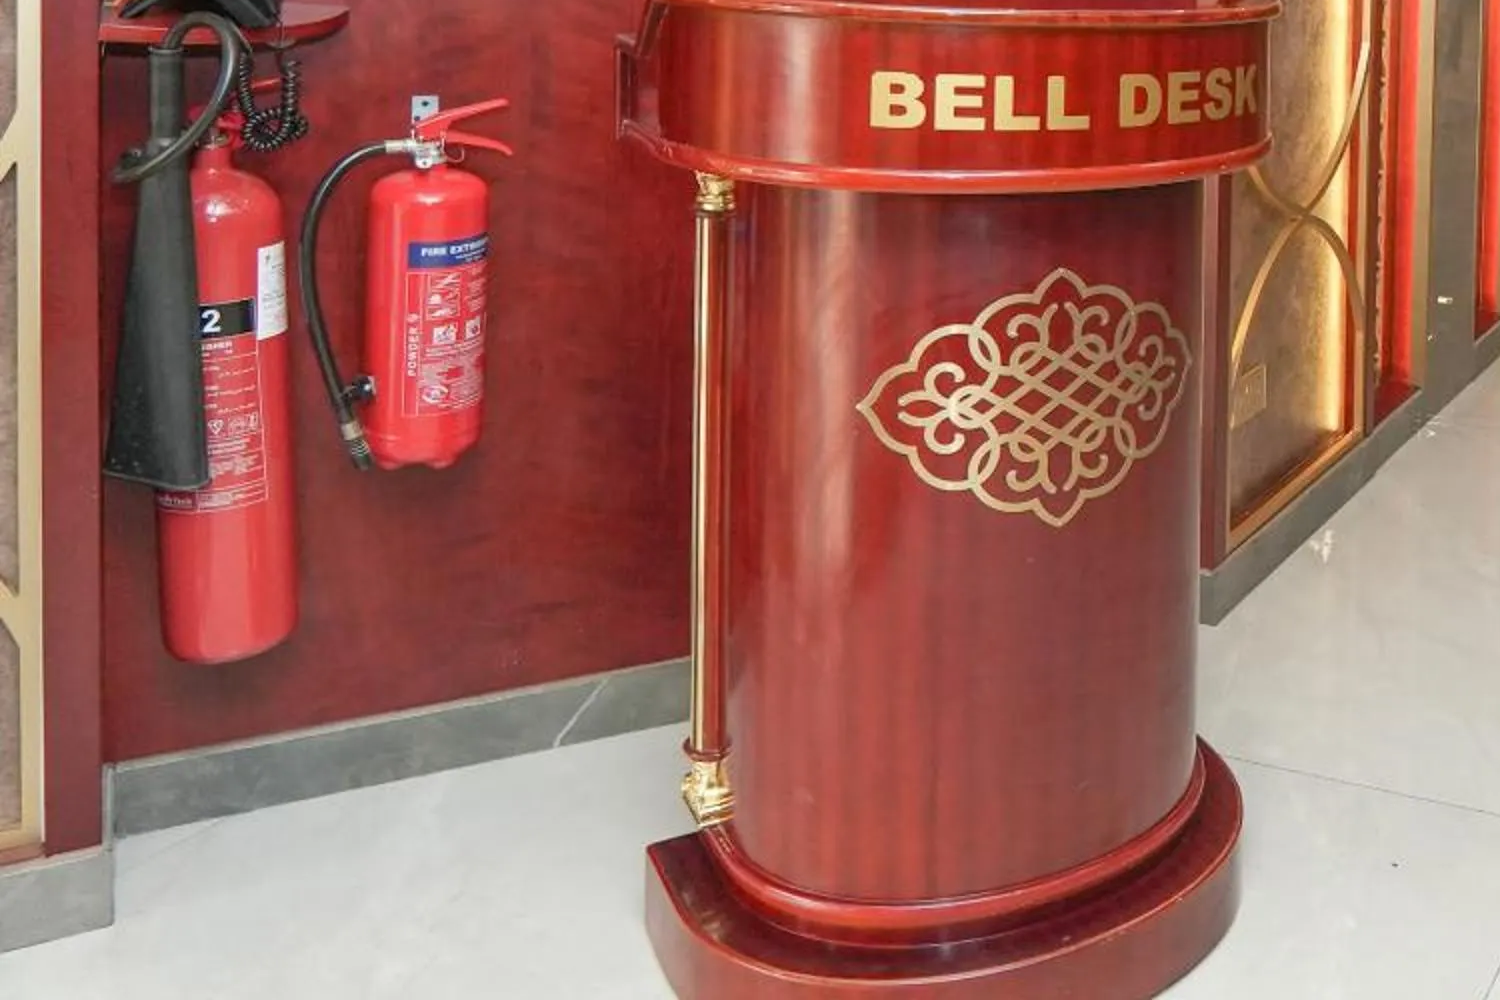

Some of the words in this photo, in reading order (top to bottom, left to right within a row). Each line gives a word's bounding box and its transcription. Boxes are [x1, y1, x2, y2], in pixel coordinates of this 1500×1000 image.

[869, 70, 1090, 131] BELL
[1119, 64, 1257, 128] DESK
[201, 309, 221, 333] 2
